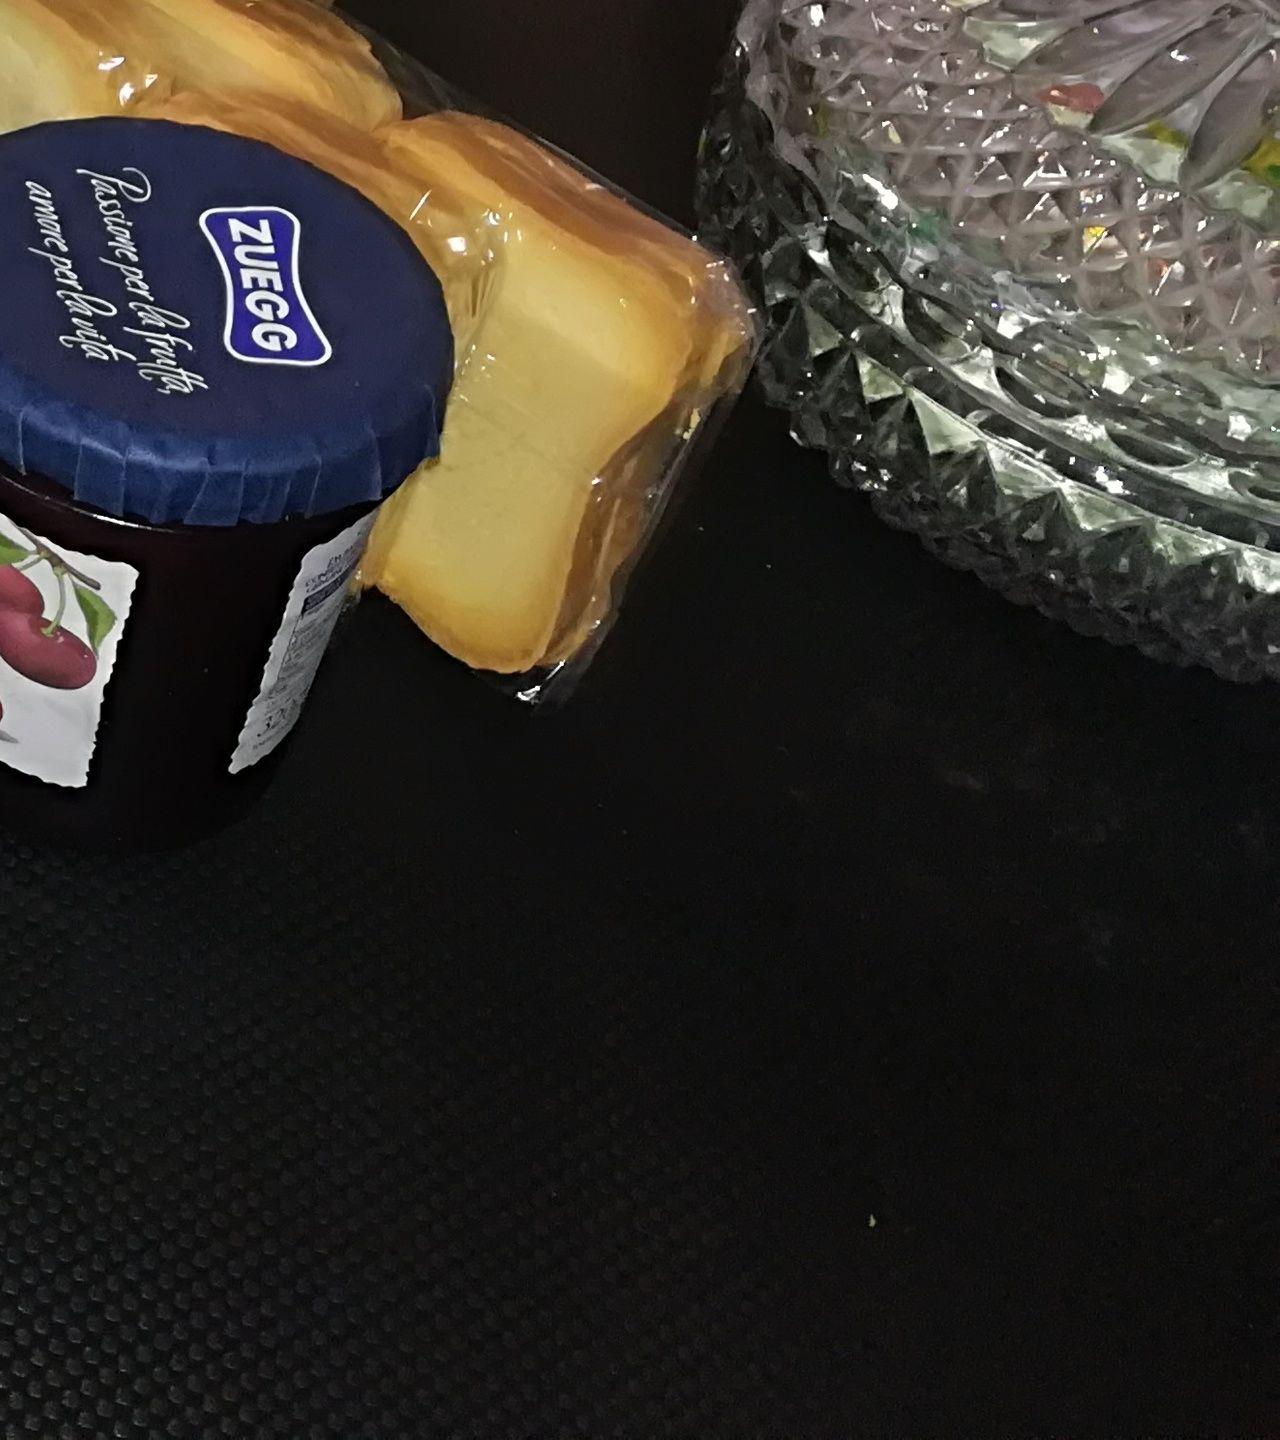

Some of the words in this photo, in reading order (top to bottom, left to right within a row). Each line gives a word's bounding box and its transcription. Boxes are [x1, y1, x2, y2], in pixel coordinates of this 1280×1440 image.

[25, 179, 69, 253] amore
[76, 167, 152, 262] Passione
[27, 246, 83, 292] per
[99, 256, 155, 302] per
[227, 217, 297, 352] ZUEGG
[56, 289, 117, 319] la
[129, 300, 191, 330] la
[59, 316, 137, 361] vita
[123, 325, 209, 395] frutta,
